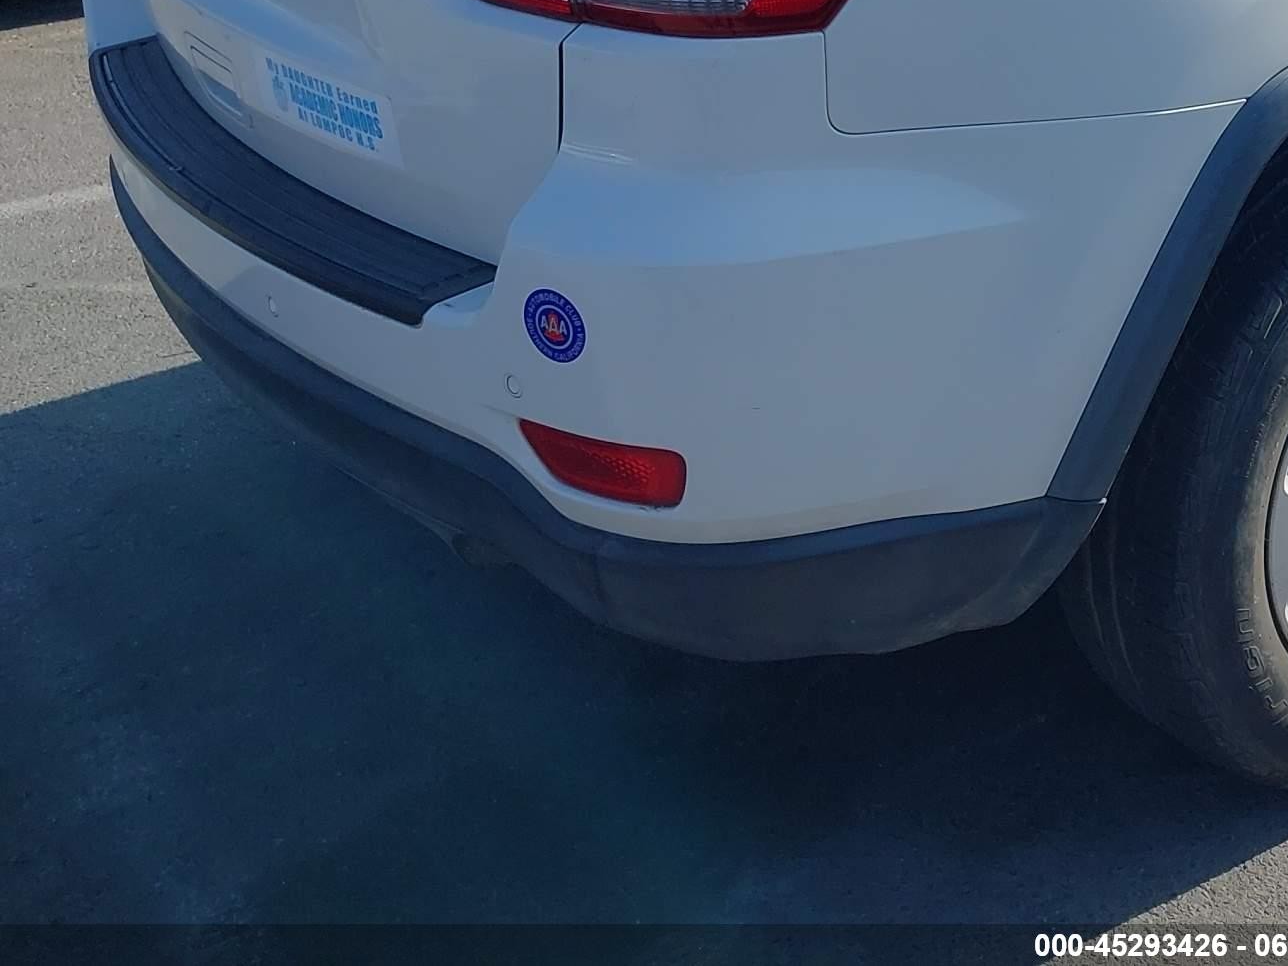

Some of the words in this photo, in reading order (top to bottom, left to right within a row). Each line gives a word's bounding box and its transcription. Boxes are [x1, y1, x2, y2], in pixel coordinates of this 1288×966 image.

[281, 64, 333, 97] DAUGHTER
[336, 87, 378, 114] Earned
[289, 82, 338, 121] ACADEMIC
[337, 103, 383, 138] HONORS
[310, 112, 353, 141] LOMPOC
[540, 315, 568, 336] AAA
